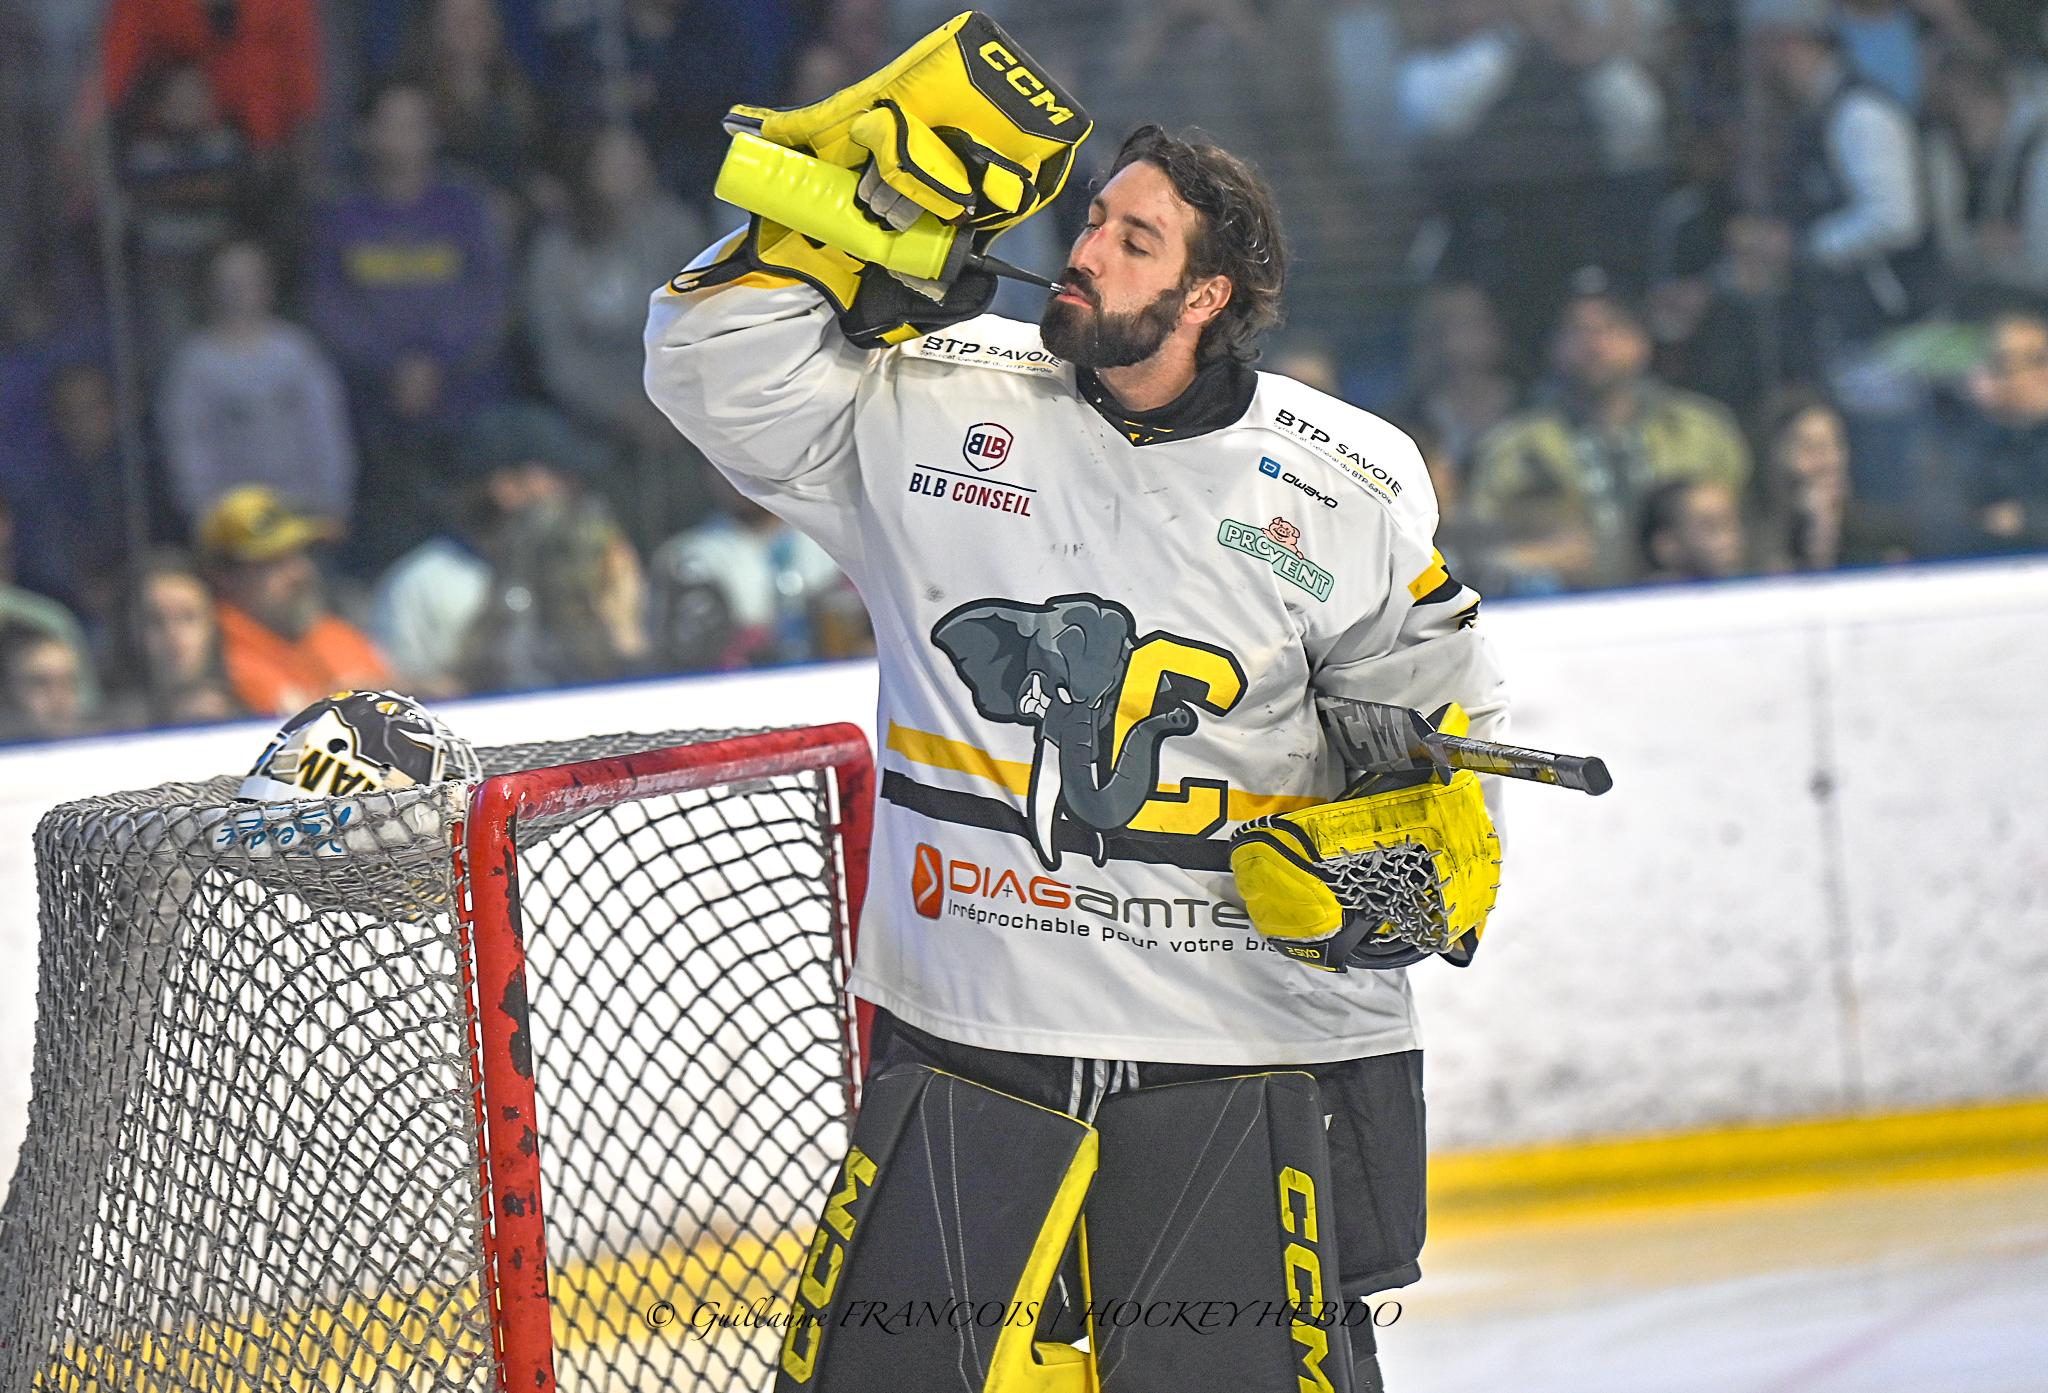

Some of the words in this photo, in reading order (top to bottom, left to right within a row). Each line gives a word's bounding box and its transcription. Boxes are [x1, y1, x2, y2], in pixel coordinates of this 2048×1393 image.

[978, 40, 1075, 126] CCM
[922, 335, 981, 355] BTP
[986, 346, 1063, 368] SAVOIE
[1275, 408, 1331, 443] BTP
[1335, 443, 1403, 498] SAVOIE
[908, 472, 948, 498] BLB
[952, 481, 1032, 517] CONSEIL
[1225, 524, 1333, 596] PROVENT
[948, 898, 1090, 937] Irréprochable
[1102, 926, 1158, 950] pour
[1169, 937, 1234, 953] votre
[781, 1145, 879, 1384] CCM
[1279, 1166, 1336, 1393] CCM
